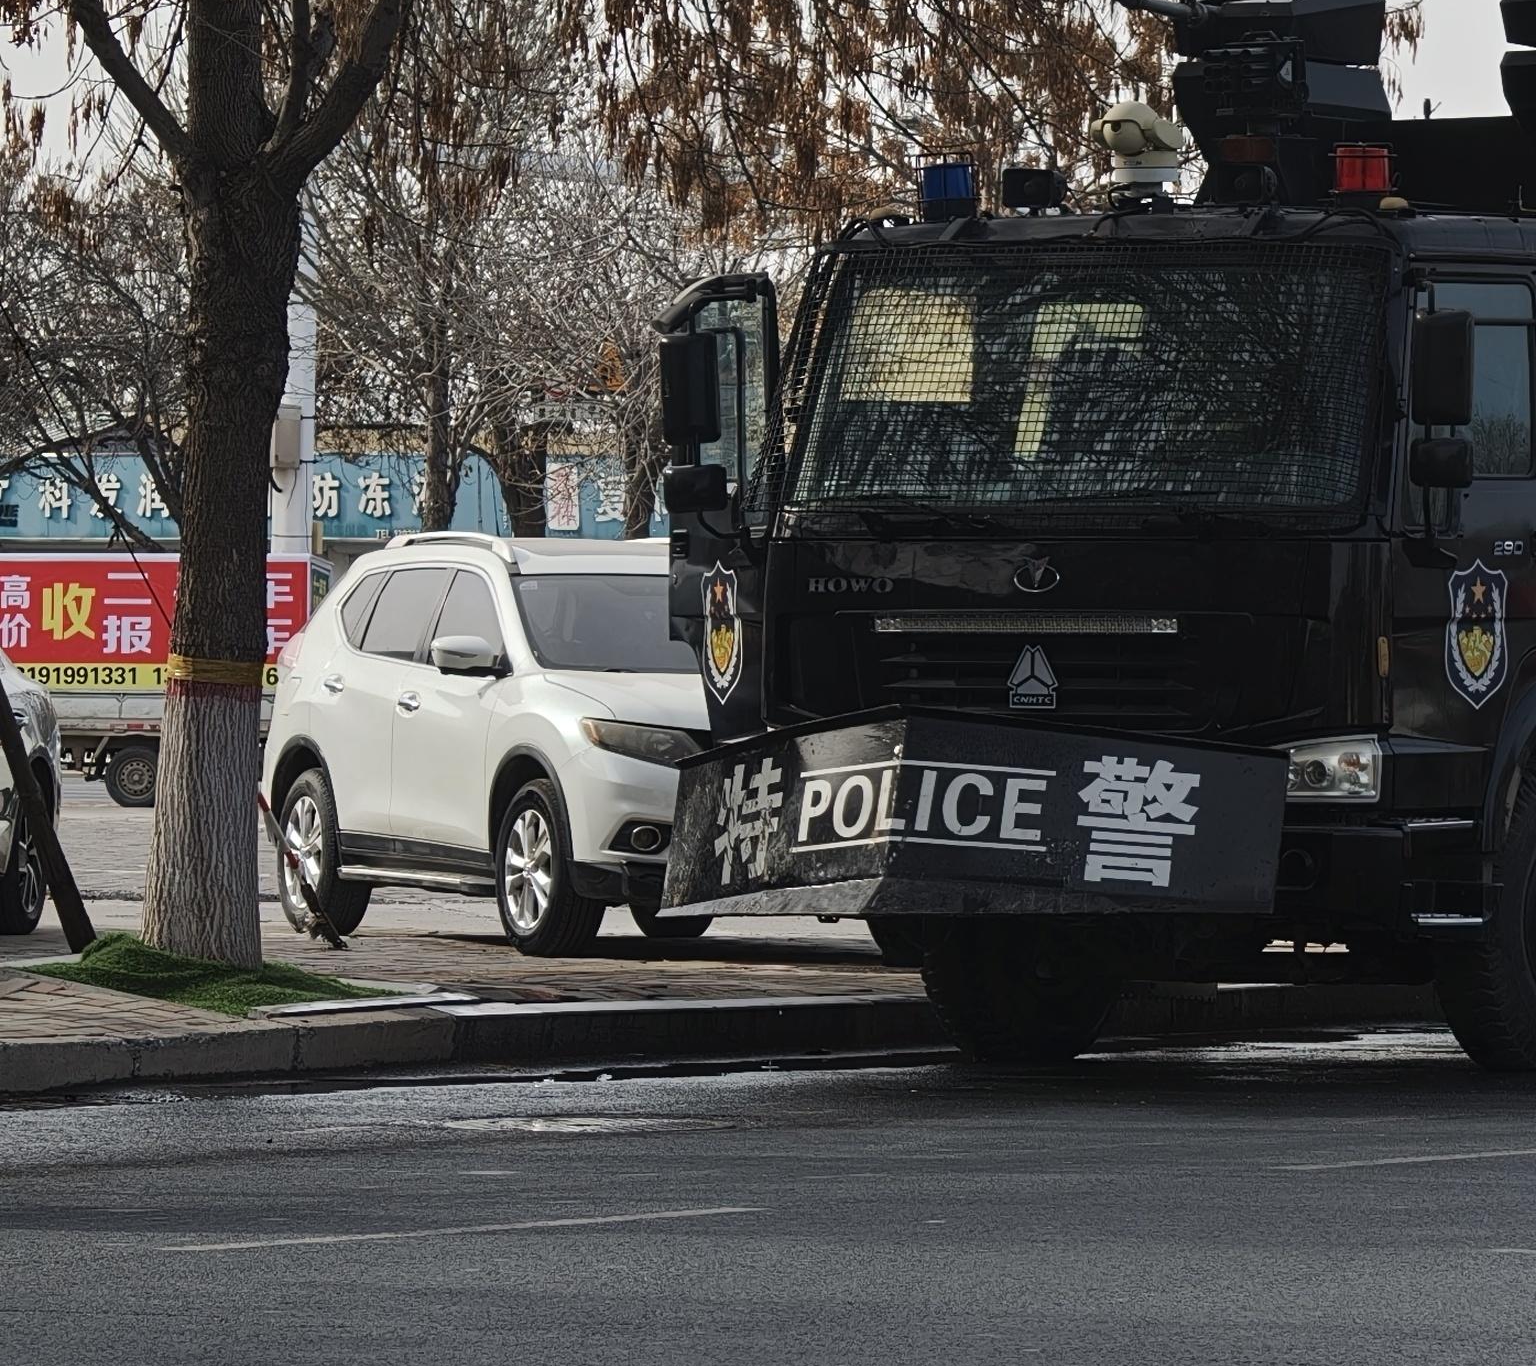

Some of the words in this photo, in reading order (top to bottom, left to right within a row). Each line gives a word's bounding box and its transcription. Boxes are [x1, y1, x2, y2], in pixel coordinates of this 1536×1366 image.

[1494, 541, 1524, 555] 290
[808, 576, 894, 593] HOWO
[0, 575, 31, 648] 高价
[42, 582, 96, 641] 收
[1013, 695, 1052, 704] CNHTC
[714, 757, 784, 885] 特
[797, 768, 1047, 842] POLICE
[1077, 755, 1200, 887] 警
